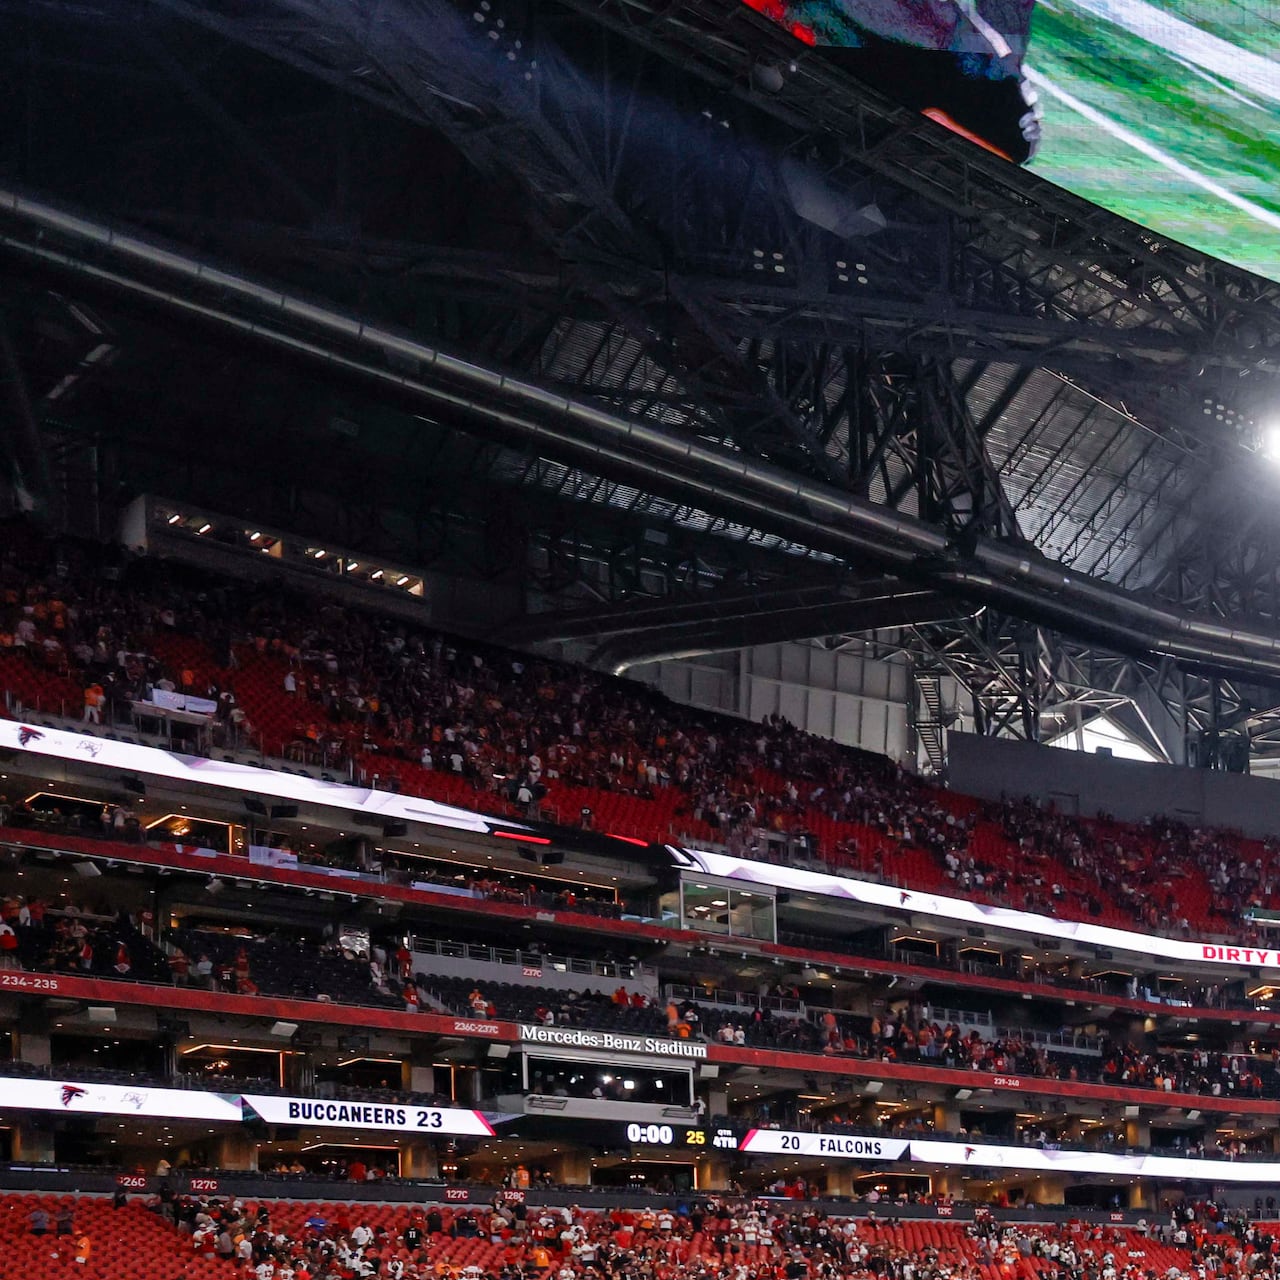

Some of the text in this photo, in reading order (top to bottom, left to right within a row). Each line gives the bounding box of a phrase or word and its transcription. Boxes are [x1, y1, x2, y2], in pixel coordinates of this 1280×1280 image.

[1203, 945, 1268, 965] DIRTY
[522, 967, 542, 978] 237C
[2, 975, 58, 989] 234-235
[454, 1022, 499, 1034] 236C-237C
[521, 1025, 707, 1058] Mercedes-Benz Stadium
[288, 1102, 443, 1128] BUCCANEERS 23
[627, 1124, 672, 1144] 0:00
[686, 1131, 705, 1144] 25
[713, 1136, 737, 1148] 4TH
[781, 1136, 882, 1155] 20 FALCONS
[191, 1179, 218, 1190] 127C
[446, 1190, 468, 1199] 127C
